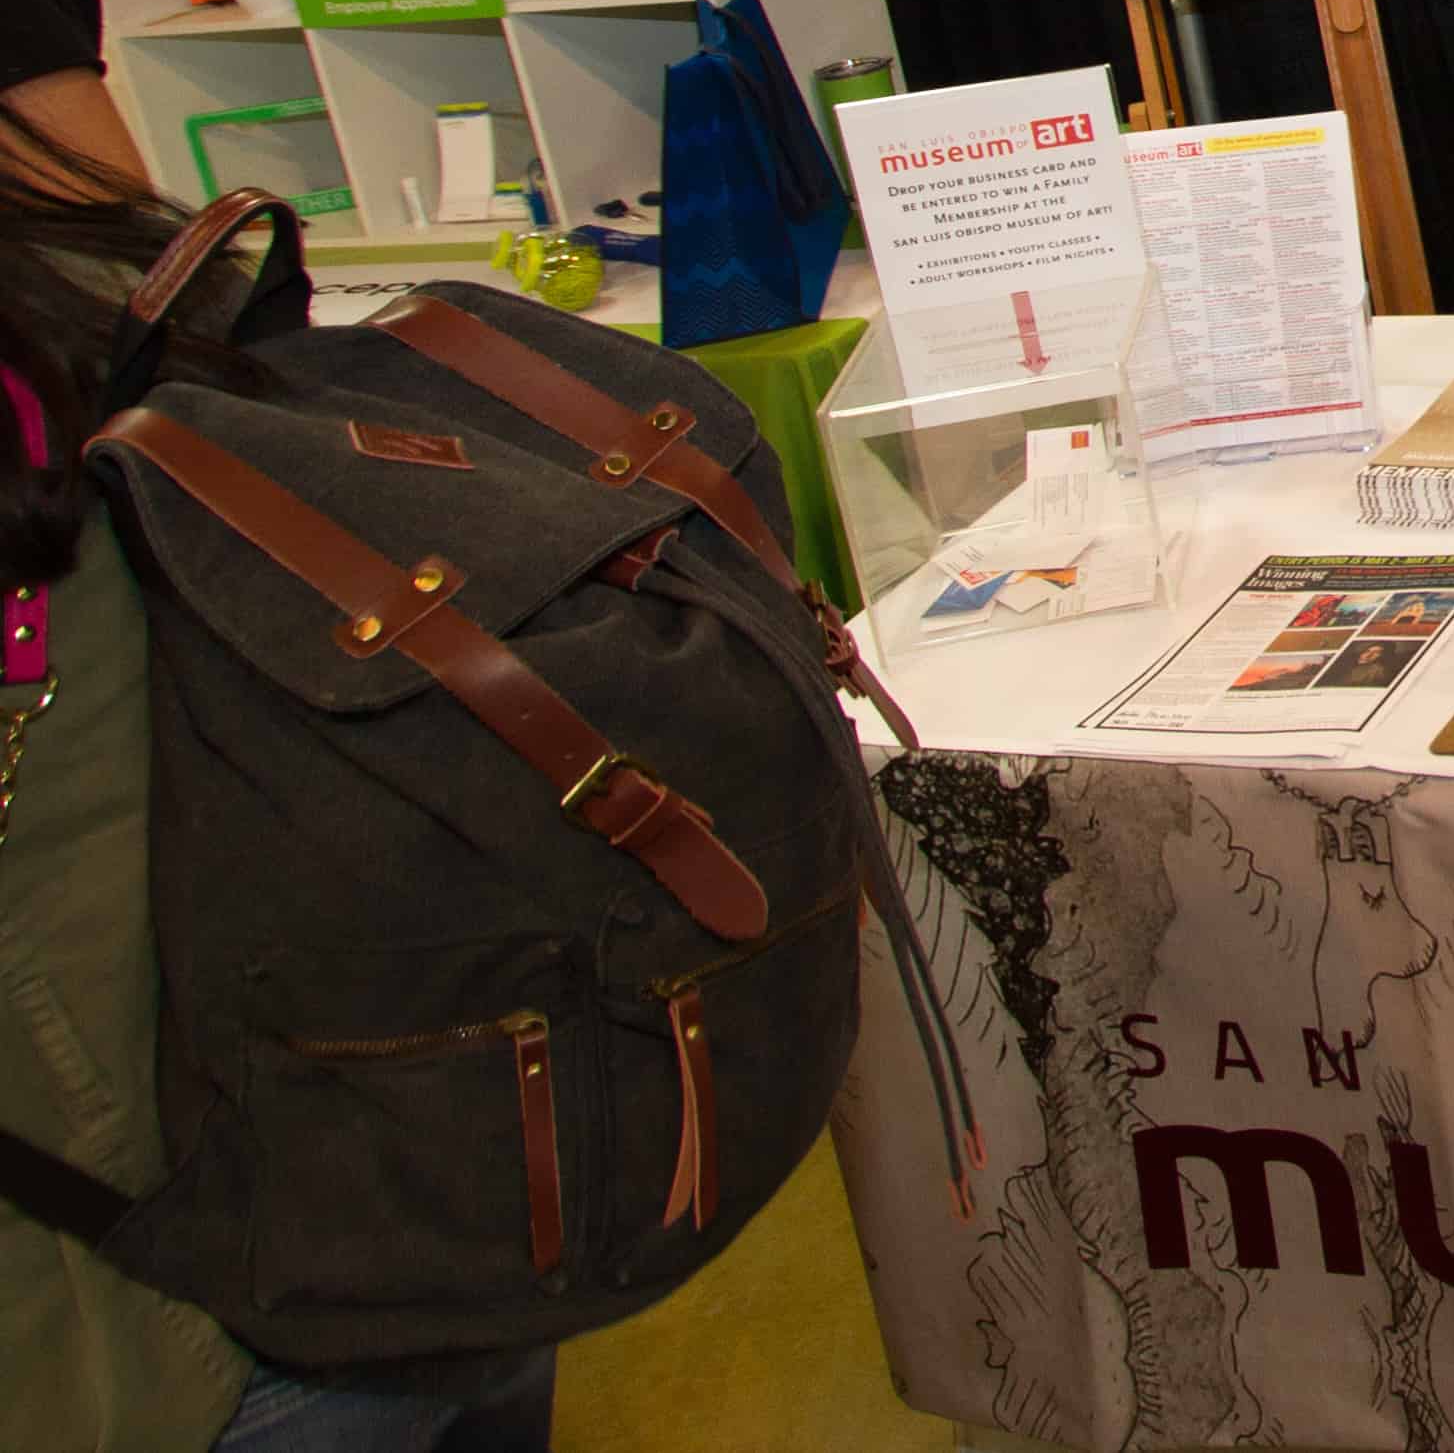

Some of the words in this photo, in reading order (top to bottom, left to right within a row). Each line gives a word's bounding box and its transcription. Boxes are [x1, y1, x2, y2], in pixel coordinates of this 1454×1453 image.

[880, 137, 1015, 175] museum
[1033, 115, 1092, 149] art
[928, 178, 964, 191] YOUR
[968, 167, 1029, 186] BUSINESS
[1032, 162, 1066, 175] CARD
[1069, 157, 1097, 170] AND
[902, 203, 916, 213] BE
[921, 193, 978, 210] ENTERED
[983, 189, 999, 200] TO
[1002, 185, 1029, 197] WIN
[1033, 183, 1041, 192] A
[1023, 199, 1038, 210] AT
[1041, 195, 1067, 207] THE
[893, 237, 919, 249] SAN
[922, 231, 952, 244] LUIS
[954, 223, 1002, 239] OBISPO
[1006, 213, 1062, 230] MUSEUM
[1066, 209, 1083, 221] OF
[918, 272, 953, 285] ADULT
[956, 260, 1025, 278] WORKSHOPS
[1035, 255, 1061, 267] FILM
[1064, 247, 1107, 261] NIGHTS
[926, 250, 997, 269] EXHIBITIONS
[1007, 243, 1045, 256] YOUTH
[1047, 234, 1093, 249] CLASSES
[1258, 568, 1329, 583] Winning
[1120, 1013, 1363, 1092] SAN
